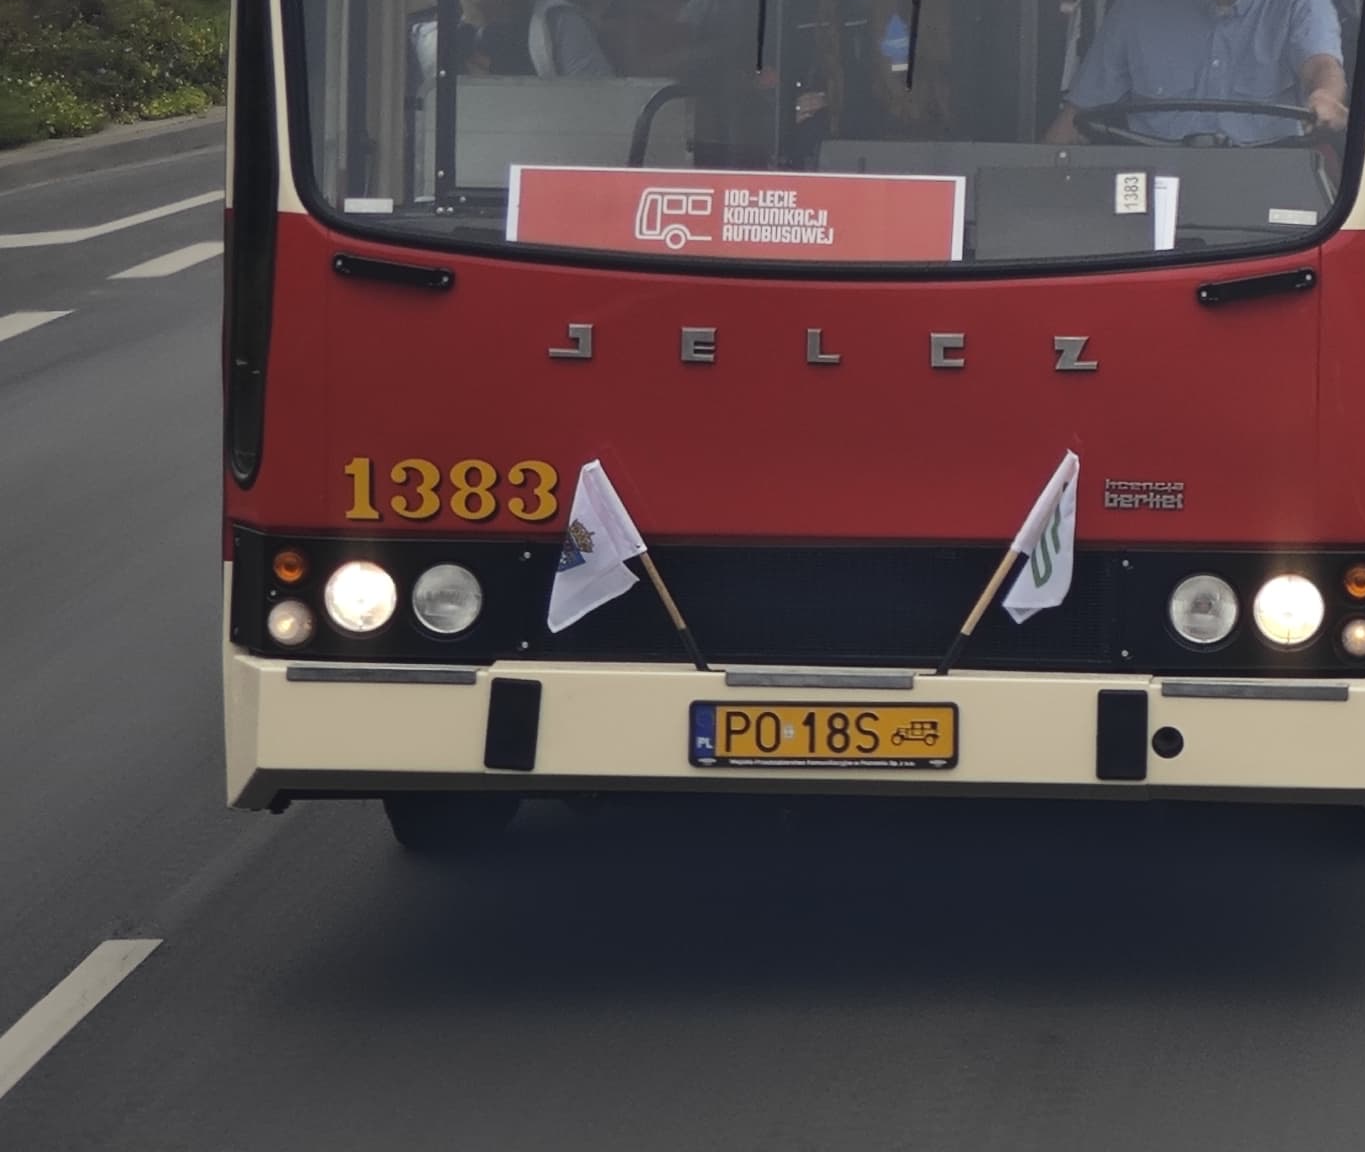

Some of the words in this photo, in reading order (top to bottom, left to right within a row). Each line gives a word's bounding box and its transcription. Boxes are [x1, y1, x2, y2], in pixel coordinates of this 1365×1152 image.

[724, 189, 797, 207] 100-LECIE
[1123, 176, 1139, 208] 1383
[723, 206, 828, 227] KOMUNIKACJI
[722, 224, 834, 245] AUTOBUSOWEJ
[344, 457, 559, 521] 1383
[697, 737, 713, 749] PL
[725, 711, 781, 753] PO
[802, 711, 880, 754] 18S
